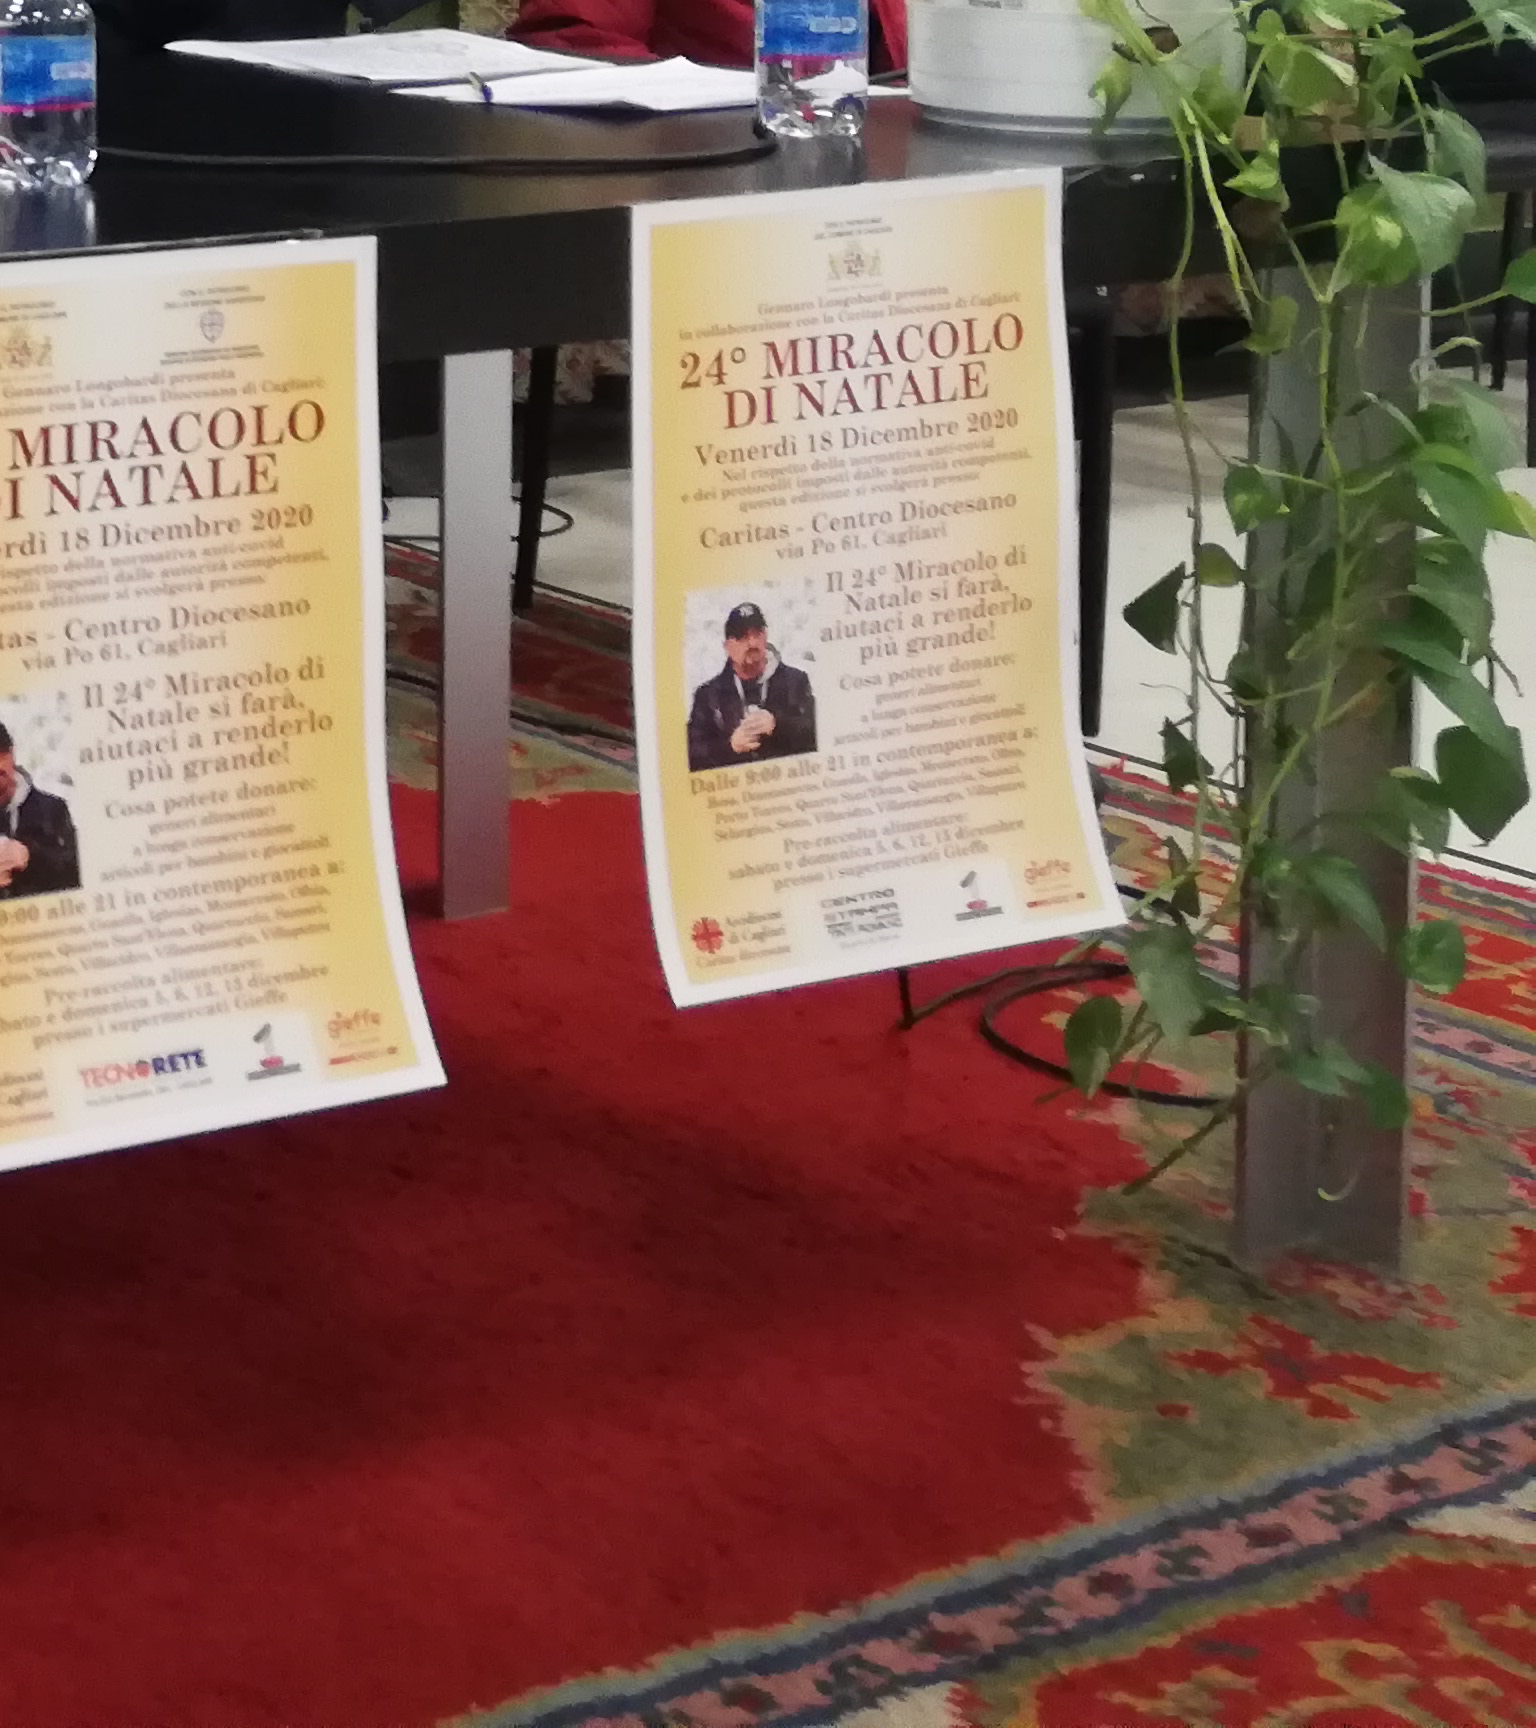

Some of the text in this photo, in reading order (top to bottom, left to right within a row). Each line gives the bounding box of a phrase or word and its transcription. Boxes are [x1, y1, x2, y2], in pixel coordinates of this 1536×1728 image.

[680, 312, 1024, 391] 24° MIRACOLO
[723, 359, 988, 430] DI NATALE
[7, 398, 325, 470] MIRACOLO
[808, 430, 833, 453] 18
[841, 417, 959, 450] Dicembre
[966, 407, 1019, 434] 2020
[44, 451, 280, 517] NATALE
[60, 526, 90, 553] 18
[99, 512, 241, 549] Dicembre
[250, 503, 314, 532] 2020
[699, 523, 791, 550] Caritas
[811, 509, 894, 534] Centro
[899, 493, 1018, 523] Diocesano
[775, 542, 805, 560] via
[811, 536, 836, 555] Po
[871, 521, 948, 548] Cagliari
[851, 564, 888, 589] 24°
[894, 549, 999, 584] Miracolo
[1004, 544, 1027, 567] di
[63, 616, 162, 642] Centro
[169, 598, 311, 630] Diocesano
[818, 591, 1034, 643] aiutaci a renderlo
[843, 584, 924, 615] Natale
[929, 579, 949, 602] si
[21, 651, 57, 672] via
[63, 646, 94, 667] Po
[137, 630, 228, 656] Cagliari
[859, 620, 997, 666] più grande!
[112, 676, 156, 706] 24°
[164, 661, 290, 699] Miracolo
[296, 655, 325, 682] di
[839, 673, 883, 691] Cosa
[887, 663, 946, 687] potete
[79, 708, 333, 765] aiutaci a renderlo
[107, 699, 200, 734] Natale
[207, 696, 230, 718] si
[127, 739, 290, 791] più grande!
[164, 789, 229, 815] potete
